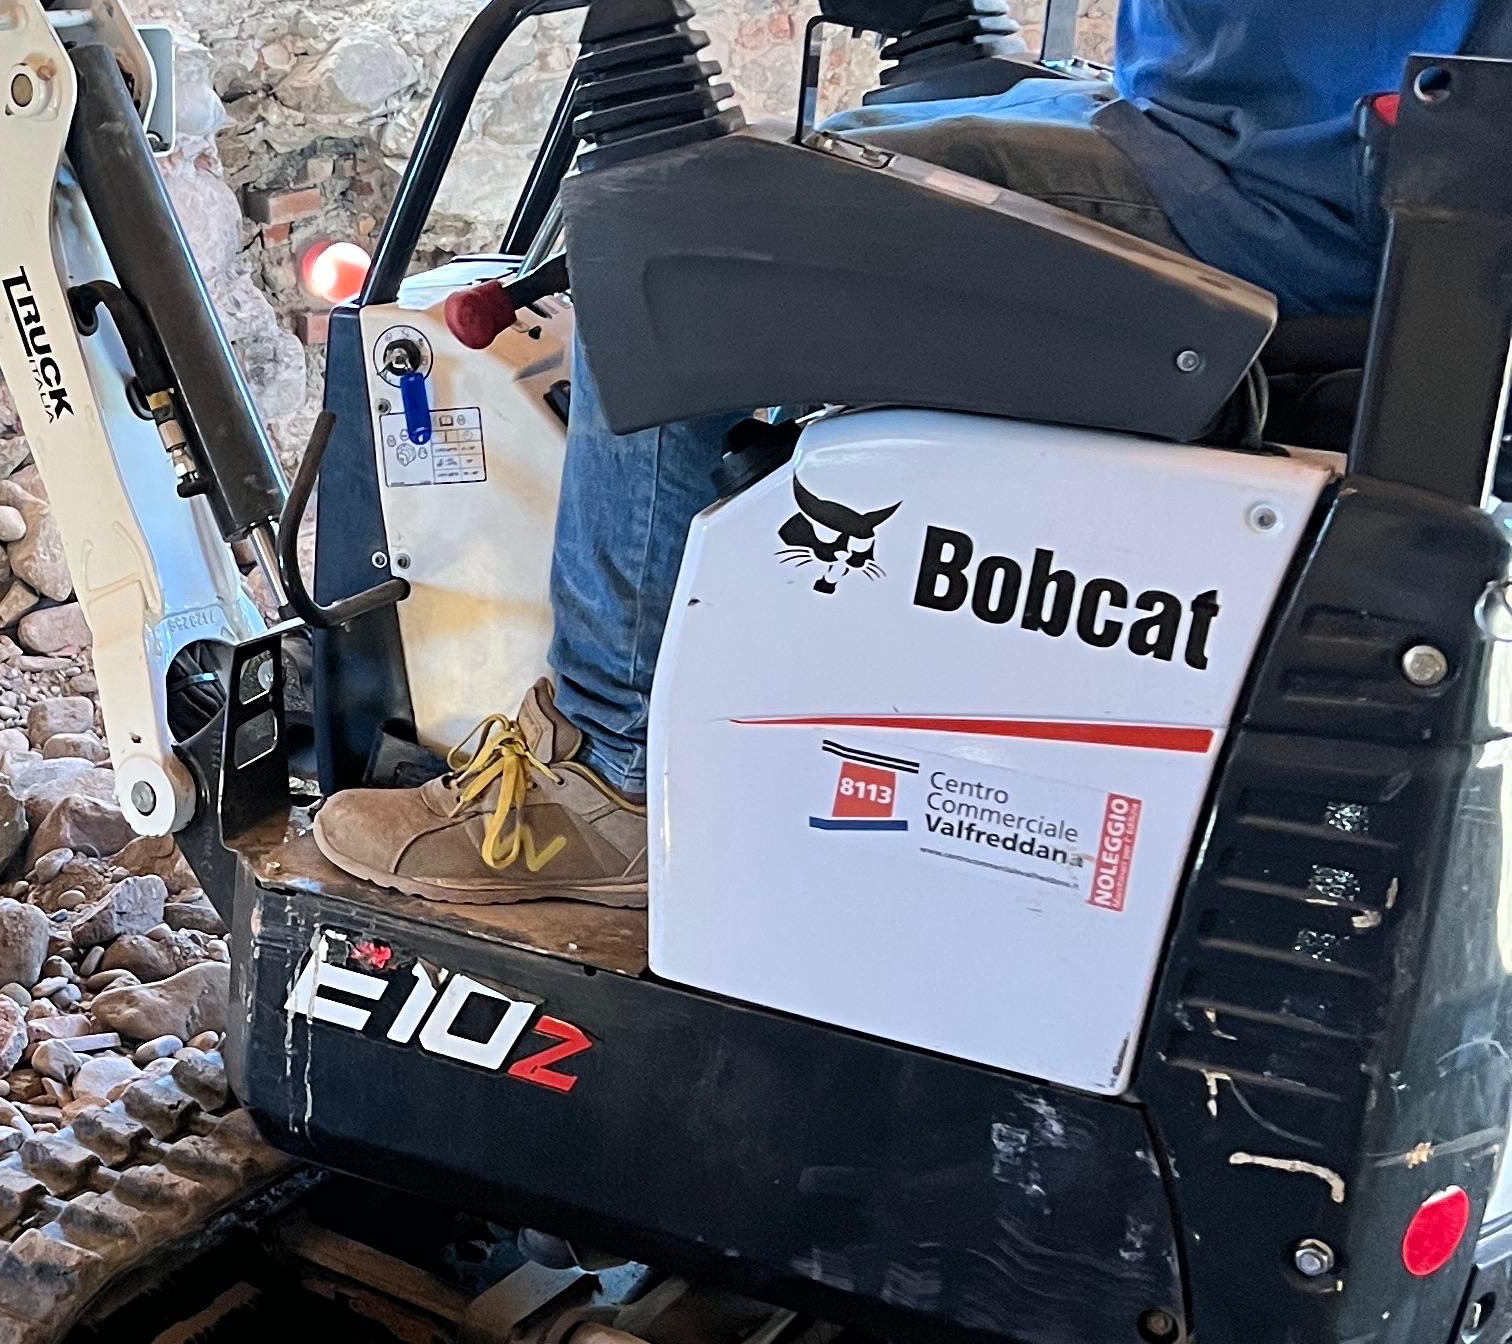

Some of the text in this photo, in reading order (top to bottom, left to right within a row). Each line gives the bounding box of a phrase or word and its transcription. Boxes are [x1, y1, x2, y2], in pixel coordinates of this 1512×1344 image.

[2, 266, 75, 419] TRUCK
[29, 359, 54, 424] ITALIA
[913, 525, 1221, 670] Bobcat
[840, 777, 892, 804] 8113
[926, 792, 1079, 843] Commerciale
[930, 771, 1009, 804] Centro
[925, 813, 1084, 868] Valfreddana
[1094, 797, 1130, 907] NOLEGGIO
